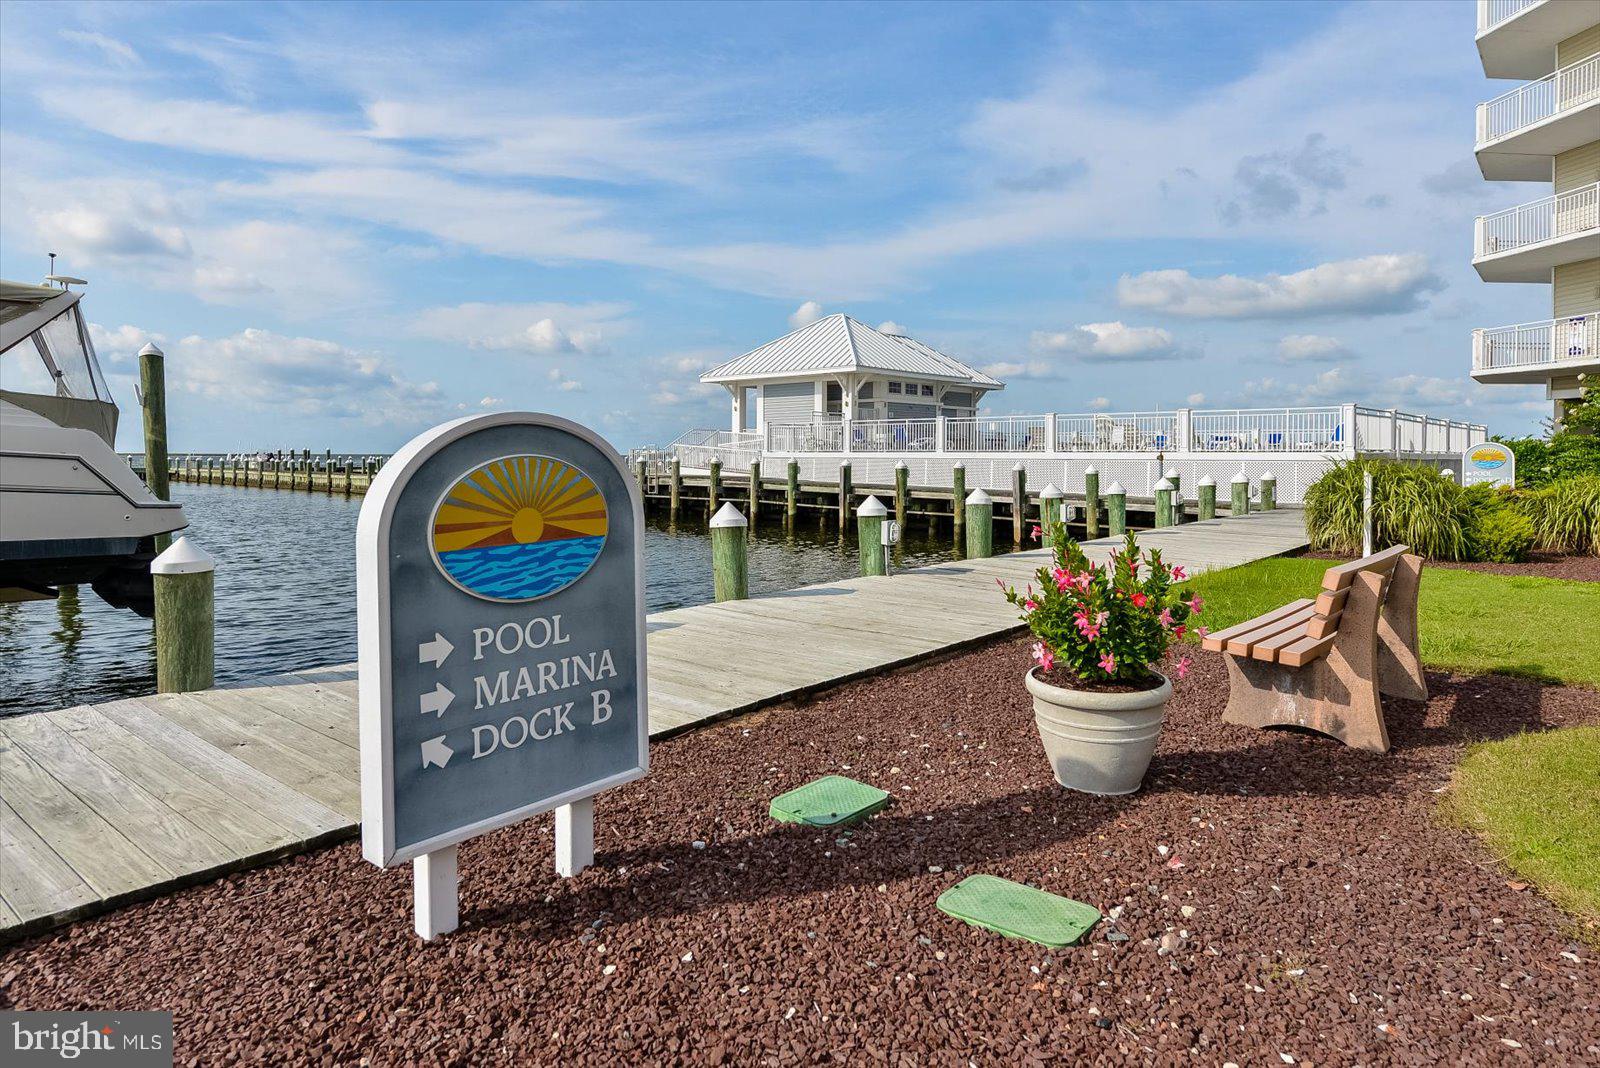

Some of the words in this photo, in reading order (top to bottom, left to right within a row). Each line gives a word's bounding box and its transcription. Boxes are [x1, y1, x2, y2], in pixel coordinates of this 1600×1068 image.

[473, 614, 570, 661] POOL
[473, 649, 618, 710] MARINA
[472, 702, 575, 759] DOCK
[591, 689, 613, 726] B
